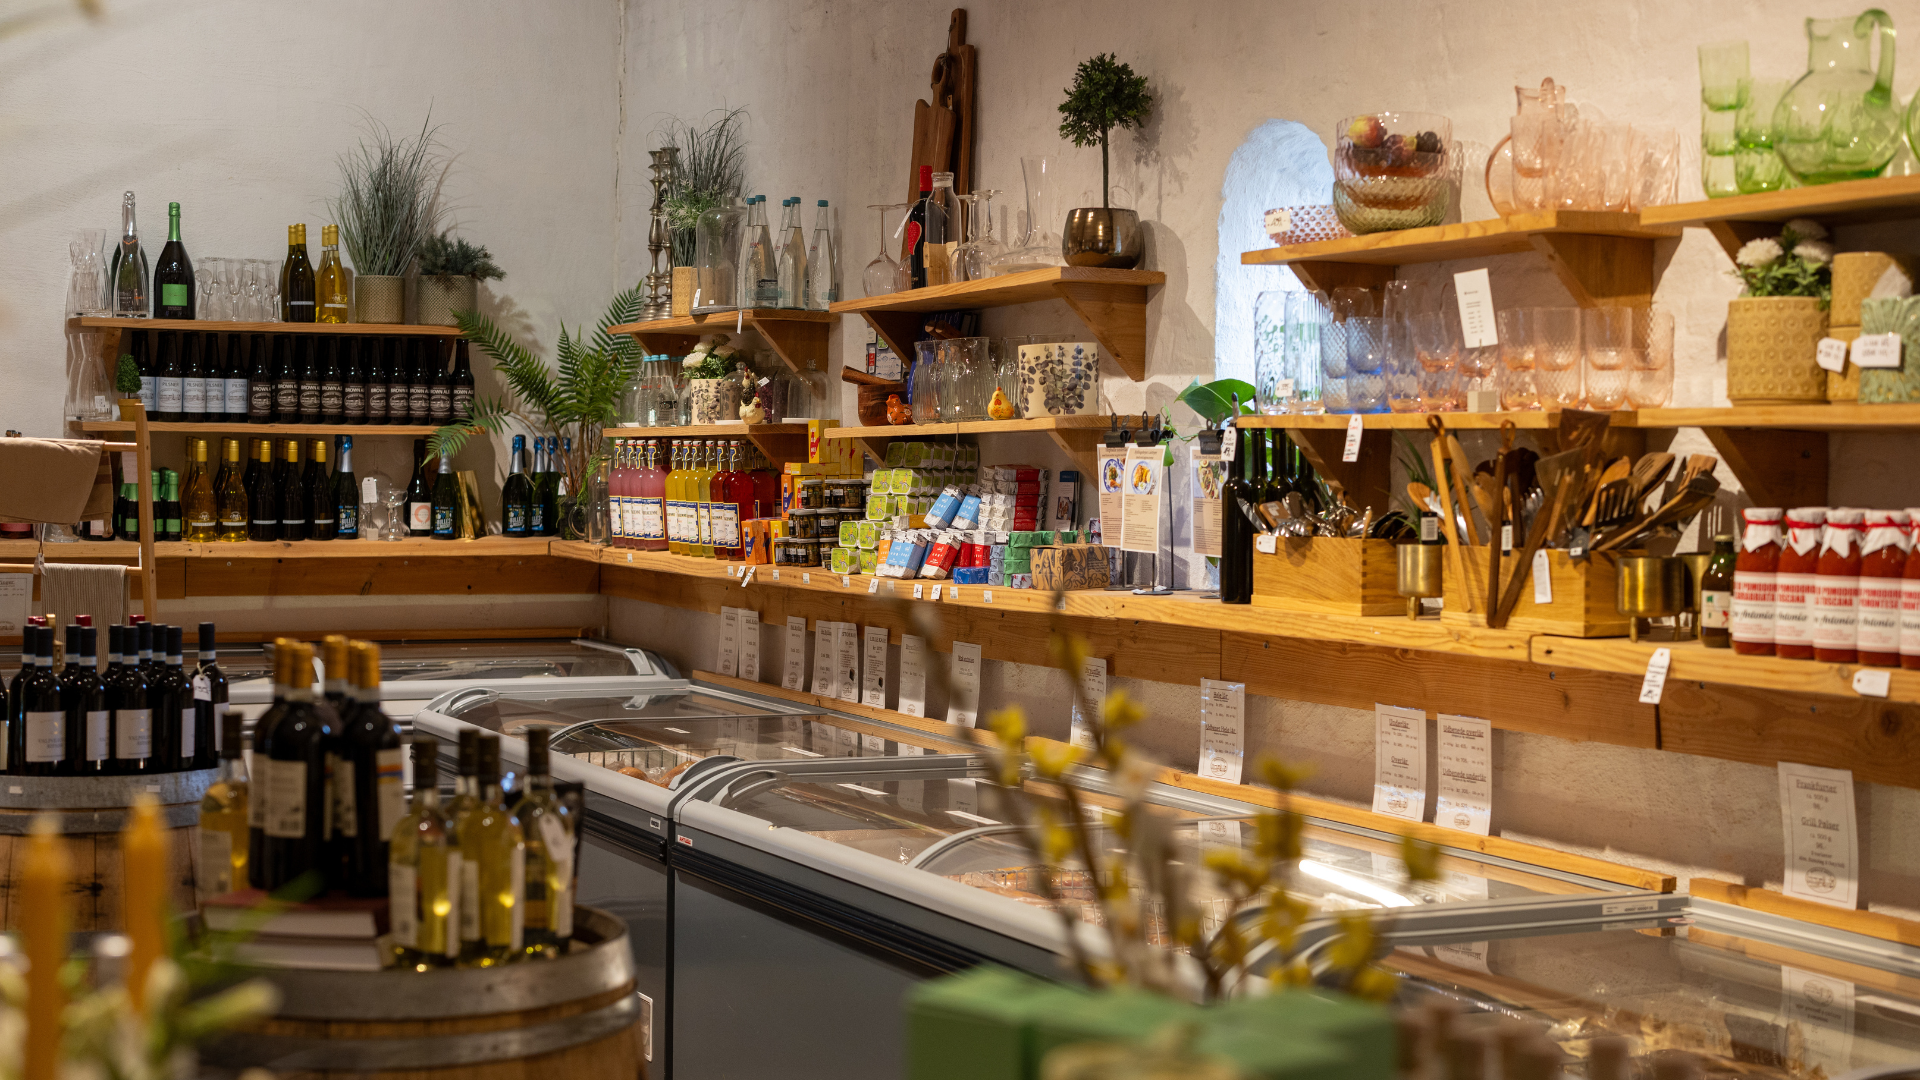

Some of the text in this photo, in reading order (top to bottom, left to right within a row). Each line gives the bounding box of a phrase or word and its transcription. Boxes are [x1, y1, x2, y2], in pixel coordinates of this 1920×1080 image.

[1388, 718, 1410, 729] Underlår
[1391, 756, 1409, 765] Overlår
[1796, 779, 1837, 793] Frankfurter
[1801, 816, 1817, 827] Grill
